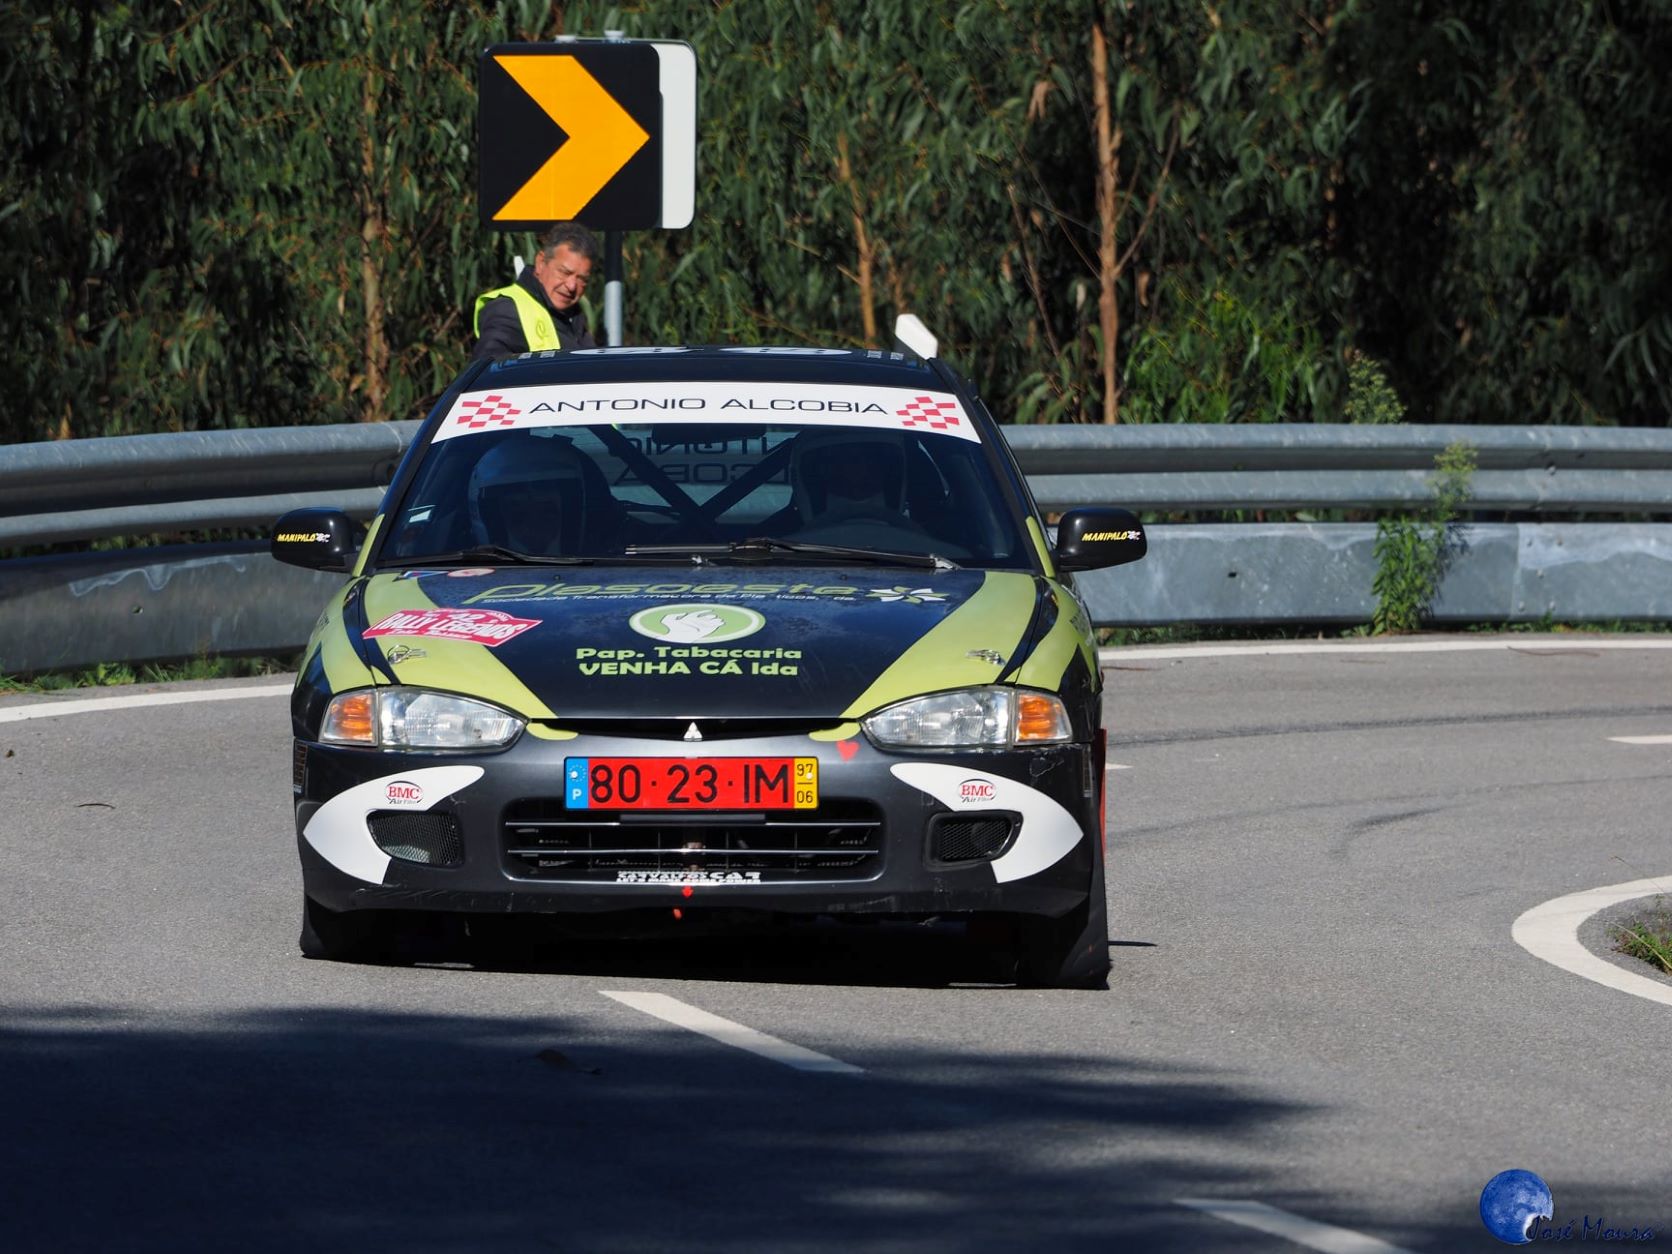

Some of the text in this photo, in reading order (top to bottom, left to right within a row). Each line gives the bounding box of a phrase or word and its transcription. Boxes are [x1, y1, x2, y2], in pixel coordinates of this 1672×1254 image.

[529, 398, 888, 415] ANTONIO ALCOBIA
[1081, 531, 1128, 541] MANIPALO
[372, 612, 437, 630] RALLY
[428, 618, 528, 640] LEGENDS
[576, 646, 802, 660] Pap. Tabacaria
[578, 661, 691, 675] VENHA
[699, 659, 743, 674] CÁ
[796, 763, 814, 779] 97
[389, 786, 420, 799] BMC
[572, 788, 582, 800] P
[796, 790, 814, 803] 06
[962, 785, 993, 797] BMC
